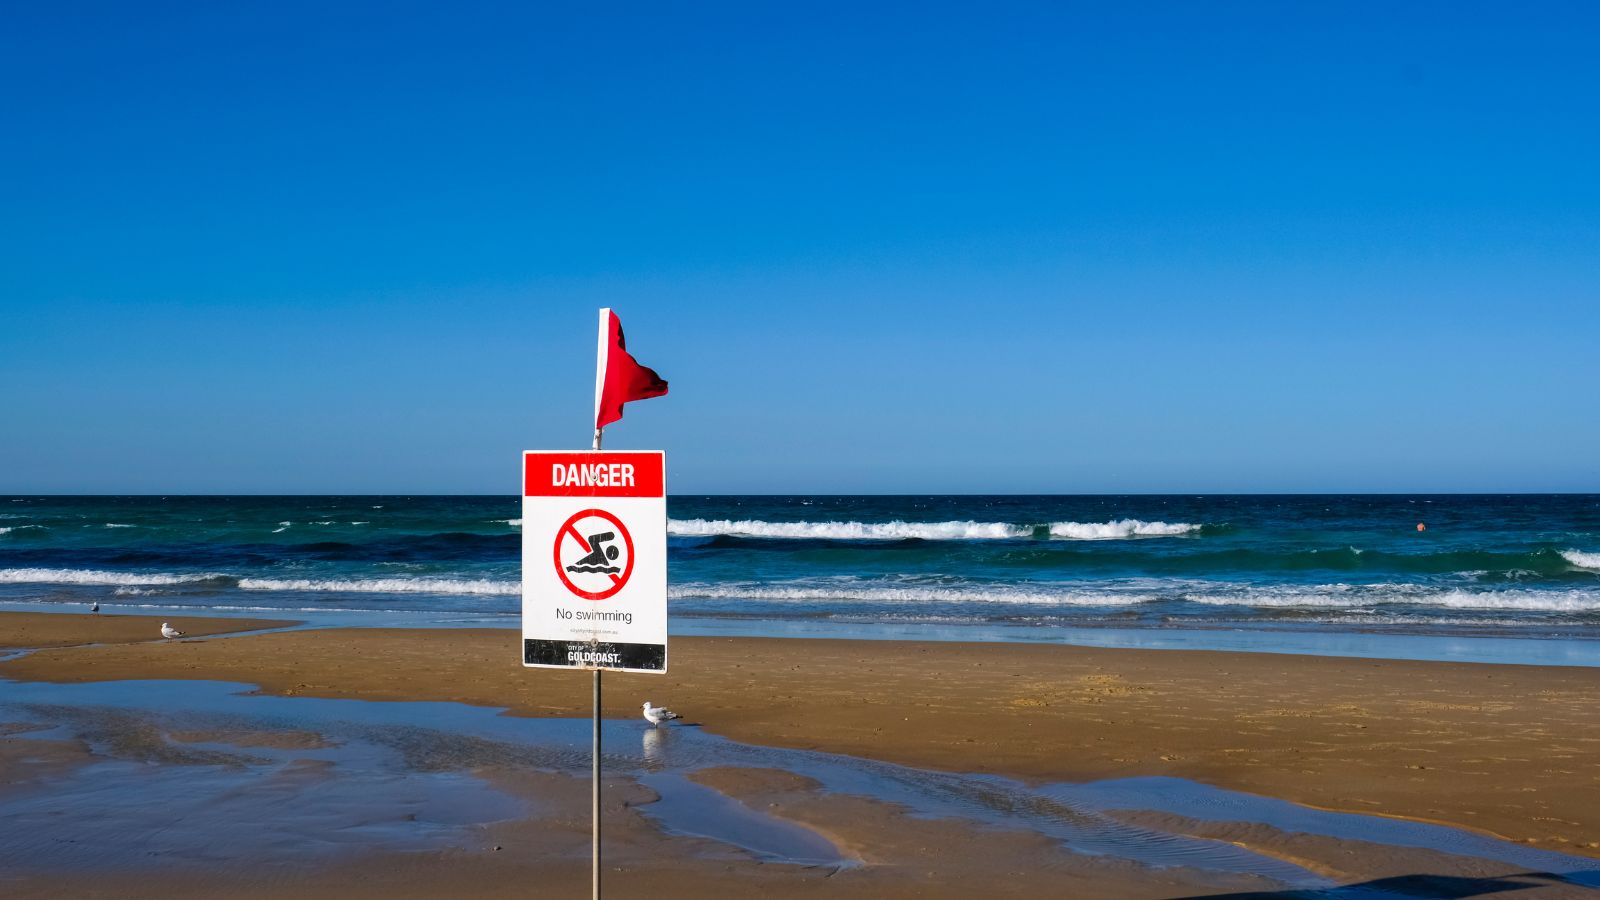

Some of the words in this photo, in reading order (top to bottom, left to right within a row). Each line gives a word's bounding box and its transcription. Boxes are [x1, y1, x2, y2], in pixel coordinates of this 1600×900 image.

[552, 464, 635, 487] DANGER
[556, 608, 572, 620] No
[576, 609, 632, 624] swimming
